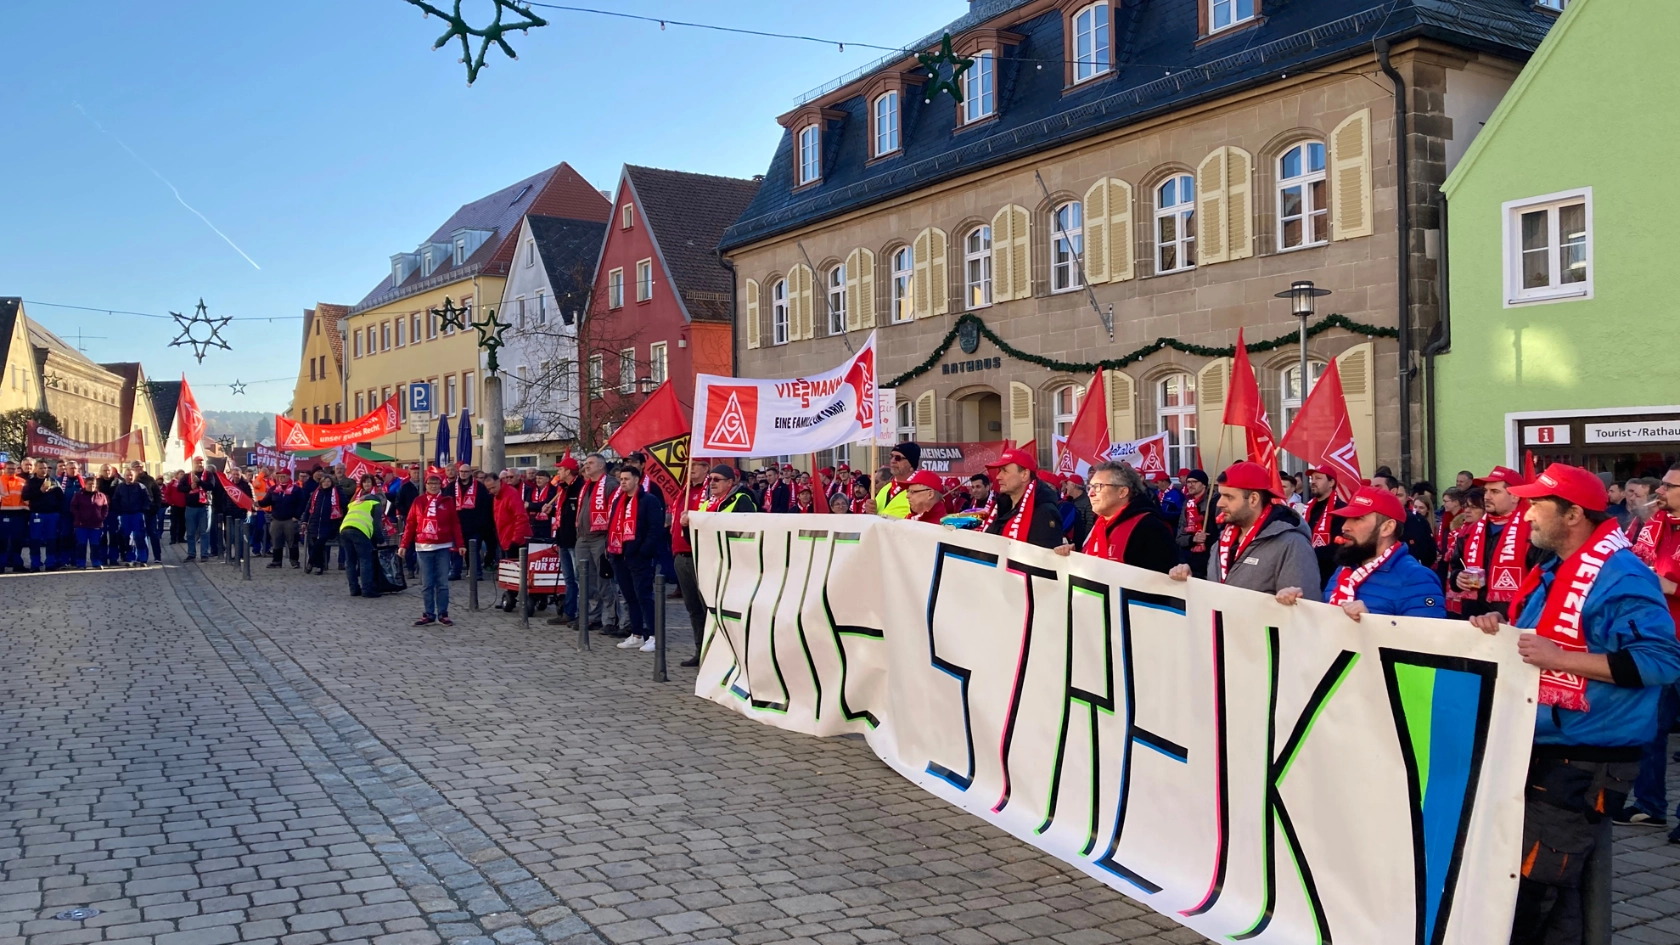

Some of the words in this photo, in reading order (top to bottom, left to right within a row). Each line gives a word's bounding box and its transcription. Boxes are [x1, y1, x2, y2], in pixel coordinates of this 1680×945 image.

[941, 356, 1001, 375] RATHAUS
[413, 387, 425, 408] P
[774, 417, 791, 429] EINE
[319, 435, 341, 443] unser
[342, 431, 362, 442] gutes
[362, 423, 380, 435] Recht
[919, 448, 962, 459] MEINSAM
[921, 460, 949, 471] STARK
[529, 560, 547, 571] FÜR
[1553, 552, 1604, 640] JETZT!
